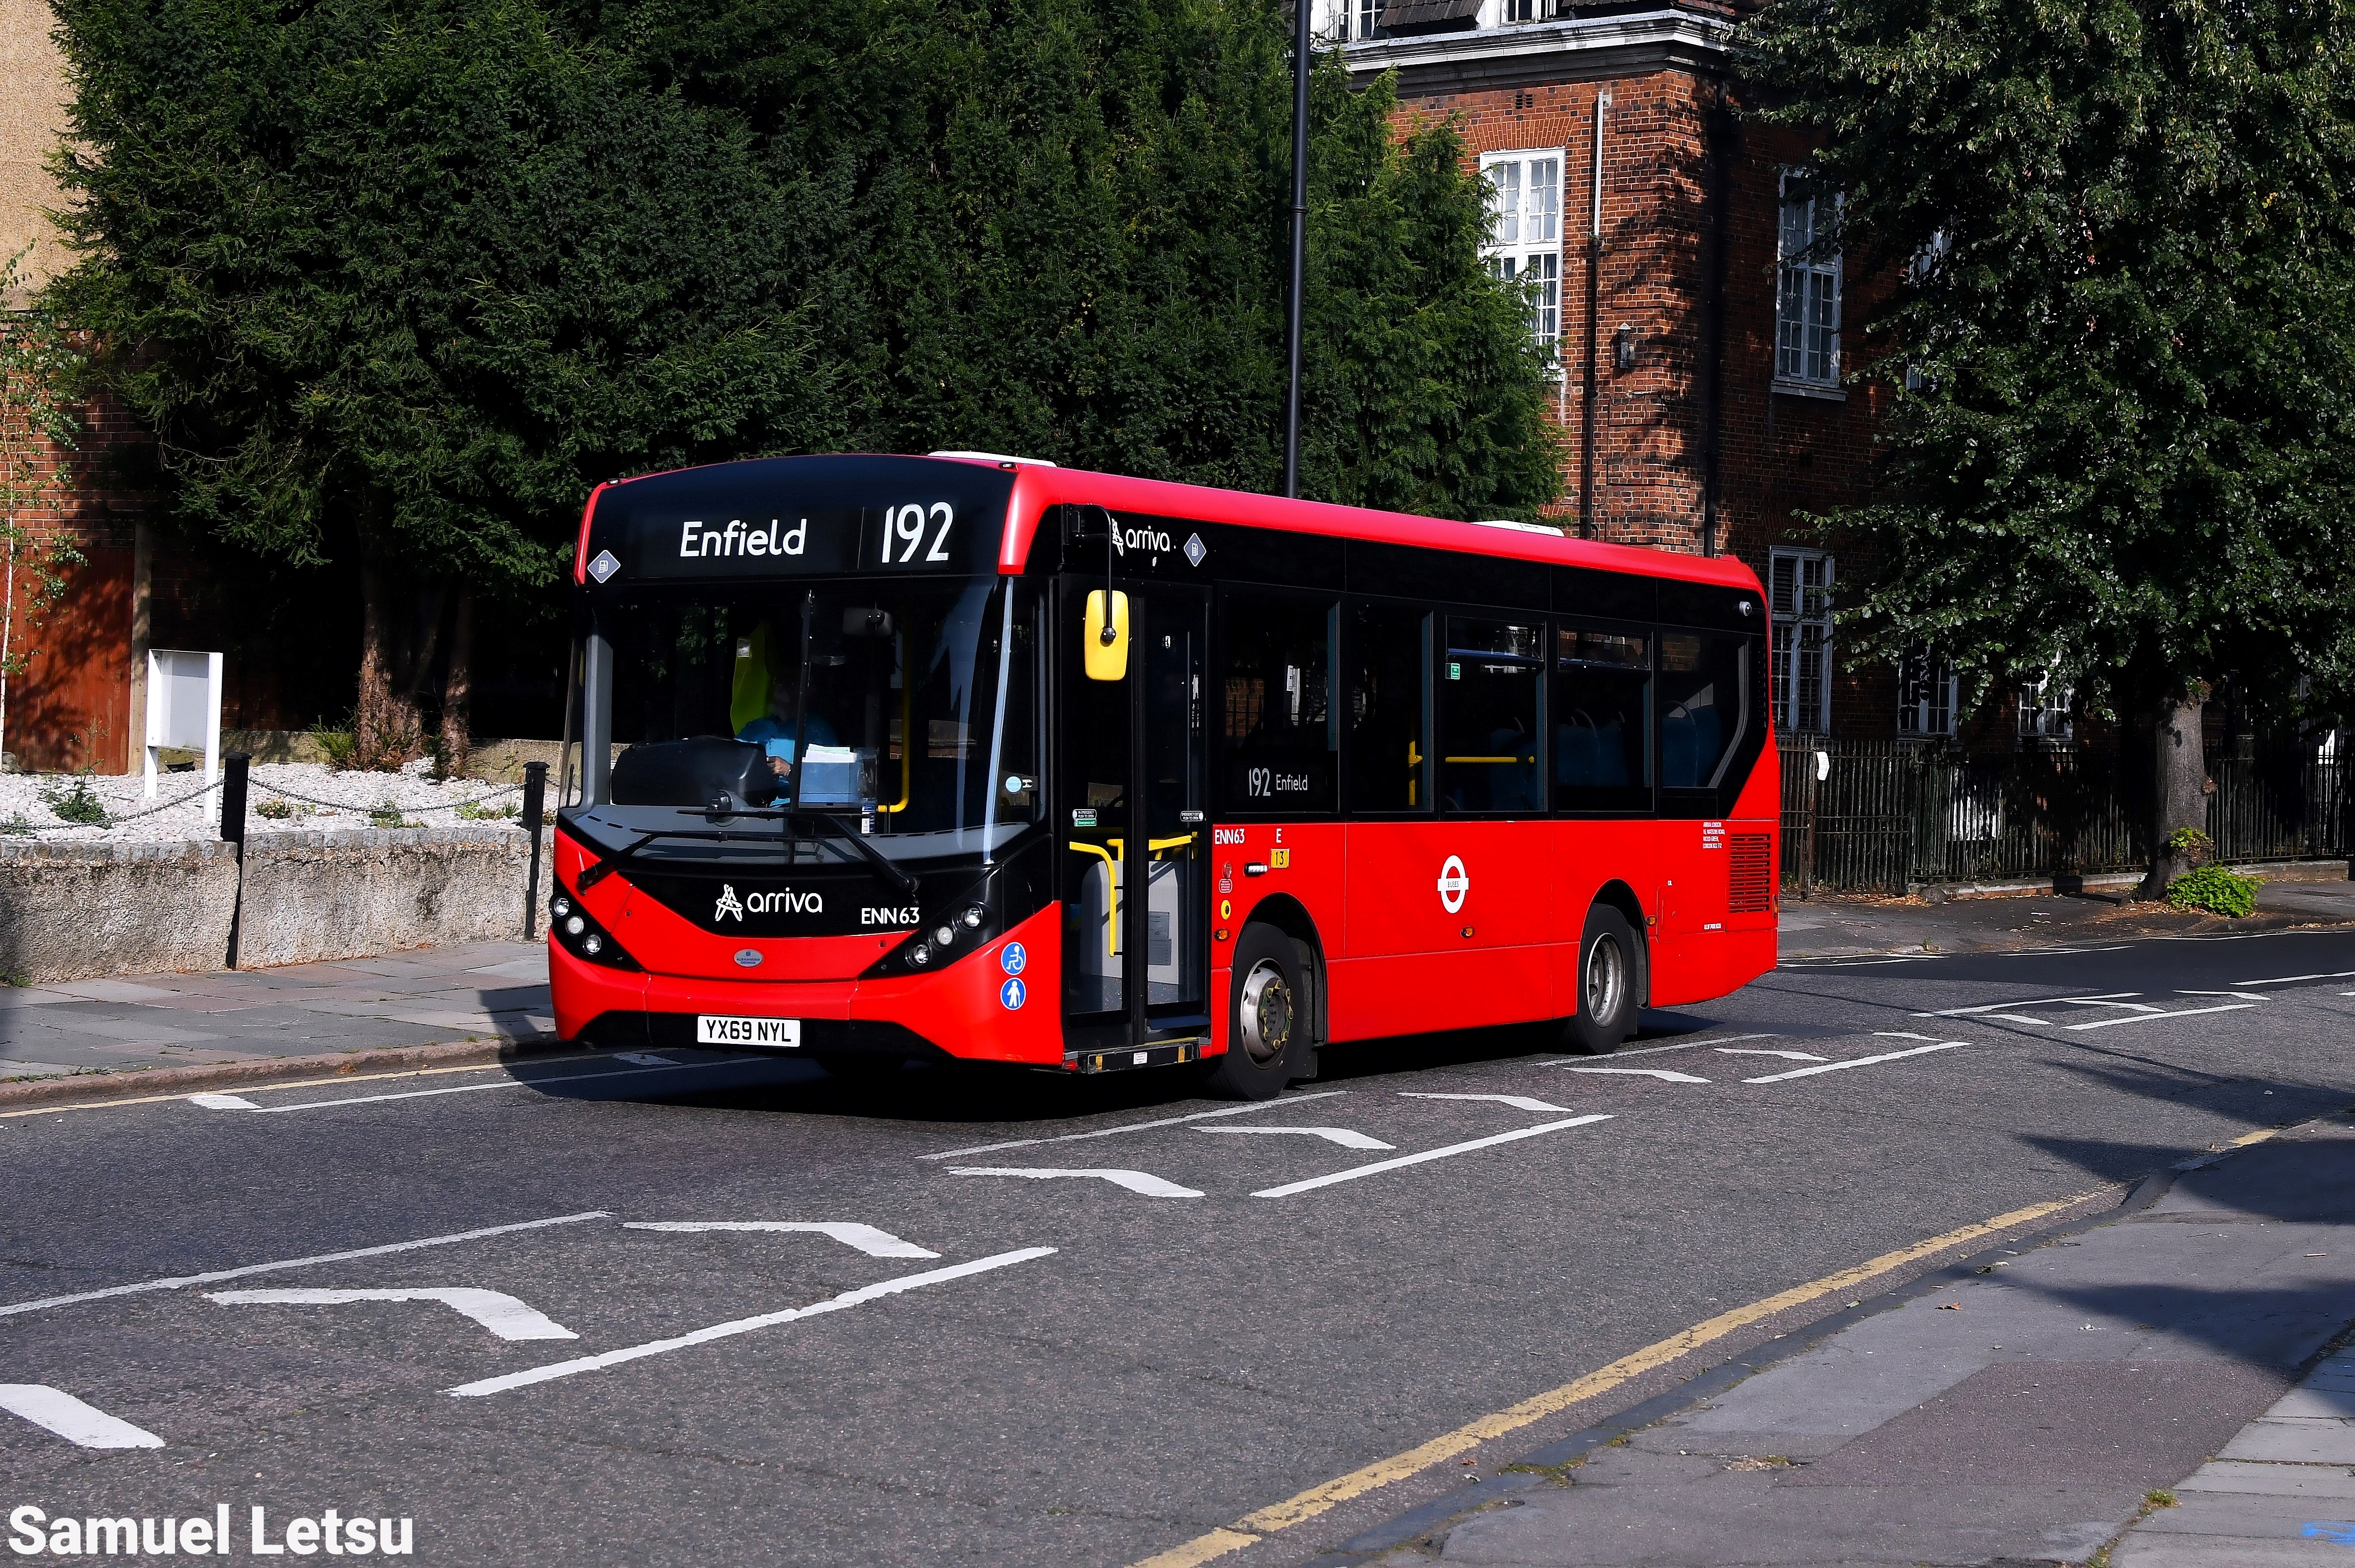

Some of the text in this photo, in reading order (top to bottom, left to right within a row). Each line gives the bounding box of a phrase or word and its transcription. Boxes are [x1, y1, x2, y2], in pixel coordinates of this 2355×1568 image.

[680, 502, 953, 563] Enfield 192
[1125, 525, 1170, 552] arriva
[1249, 768, 1308, 796] 192 Enfield
[1215, 828, 1245, 844] ENN63
[1276, 828, 1282, 843] E
[1275, 851, 1284, 865] 13
[747, 887, 822, 913] arriva
[706, 1019, 792, 1042] YX69 NYL
